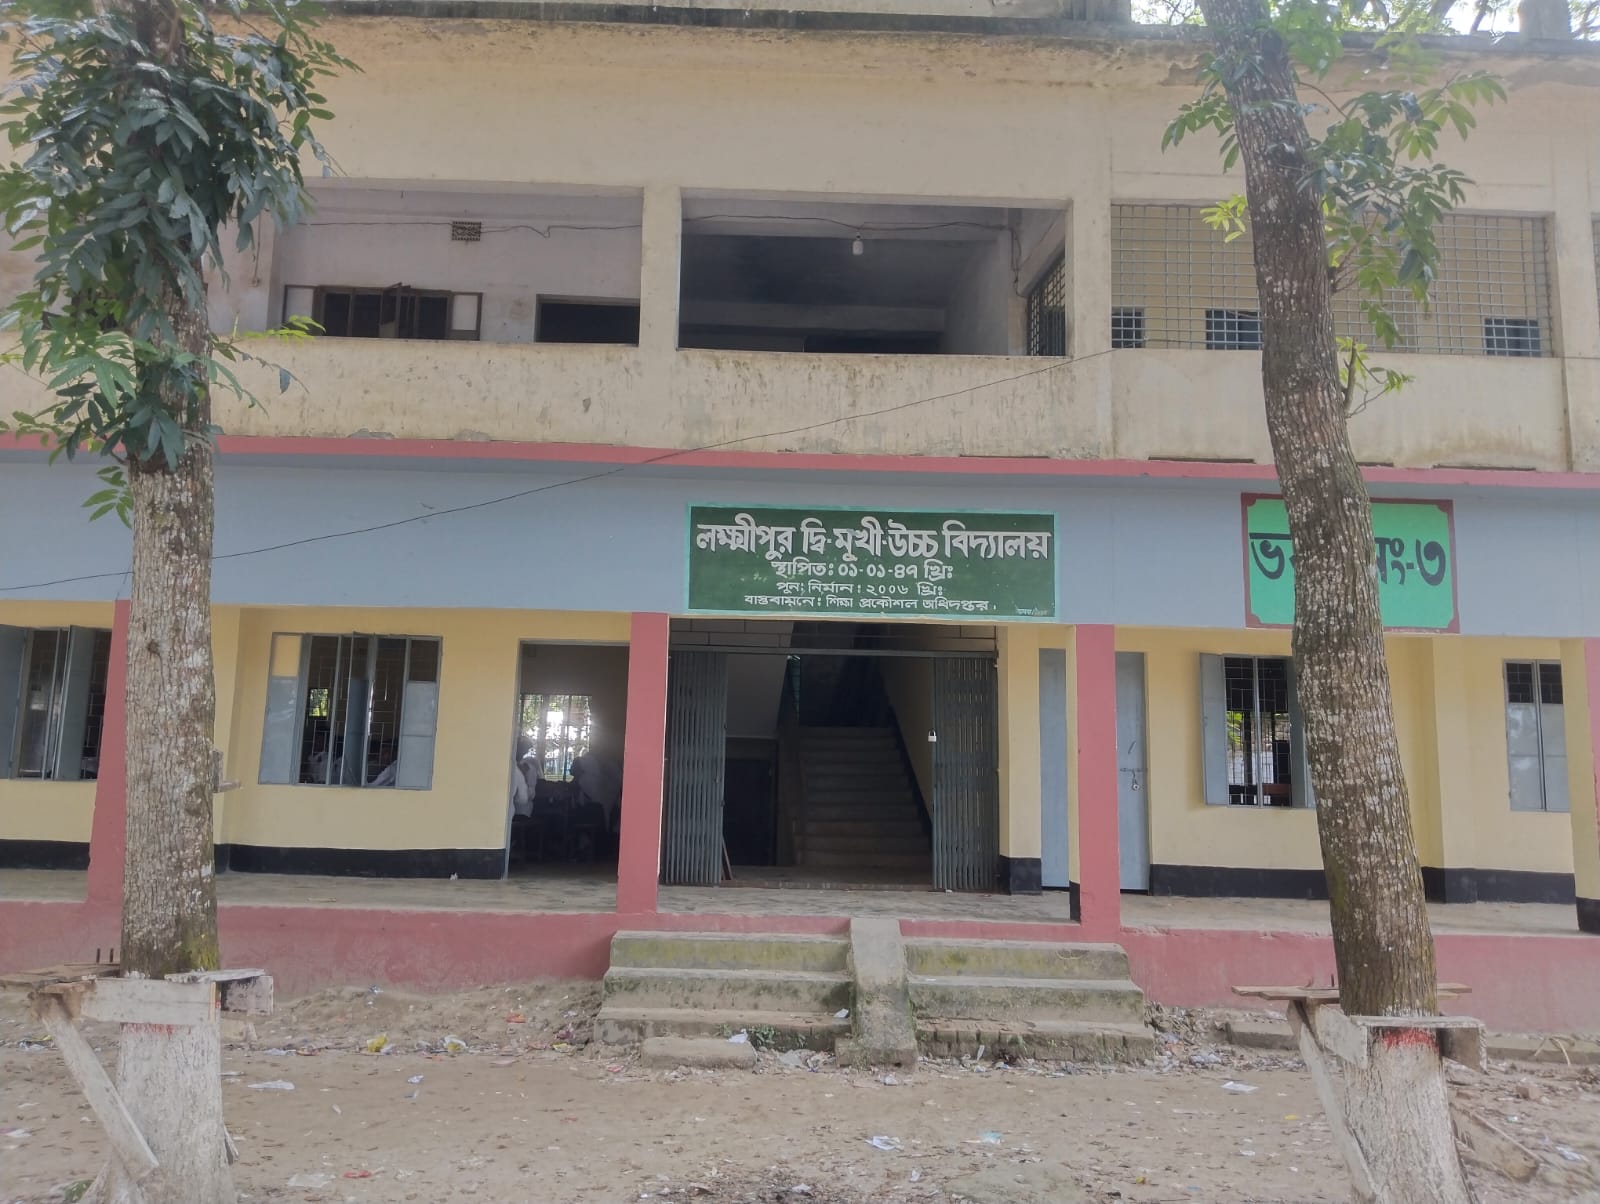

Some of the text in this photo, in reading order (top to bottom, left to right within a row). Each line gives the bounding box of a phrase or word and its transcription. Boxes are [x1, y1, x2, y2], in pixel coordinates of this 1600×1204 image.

[697, 513, 796, 560] লক্ষ্মীপুর
[941, 519, 1052, 560] বিদ্যালয়
[826, 594, 854, 608] শিক্ষা
[859, 596, 918, 609] প্রকৌশল
